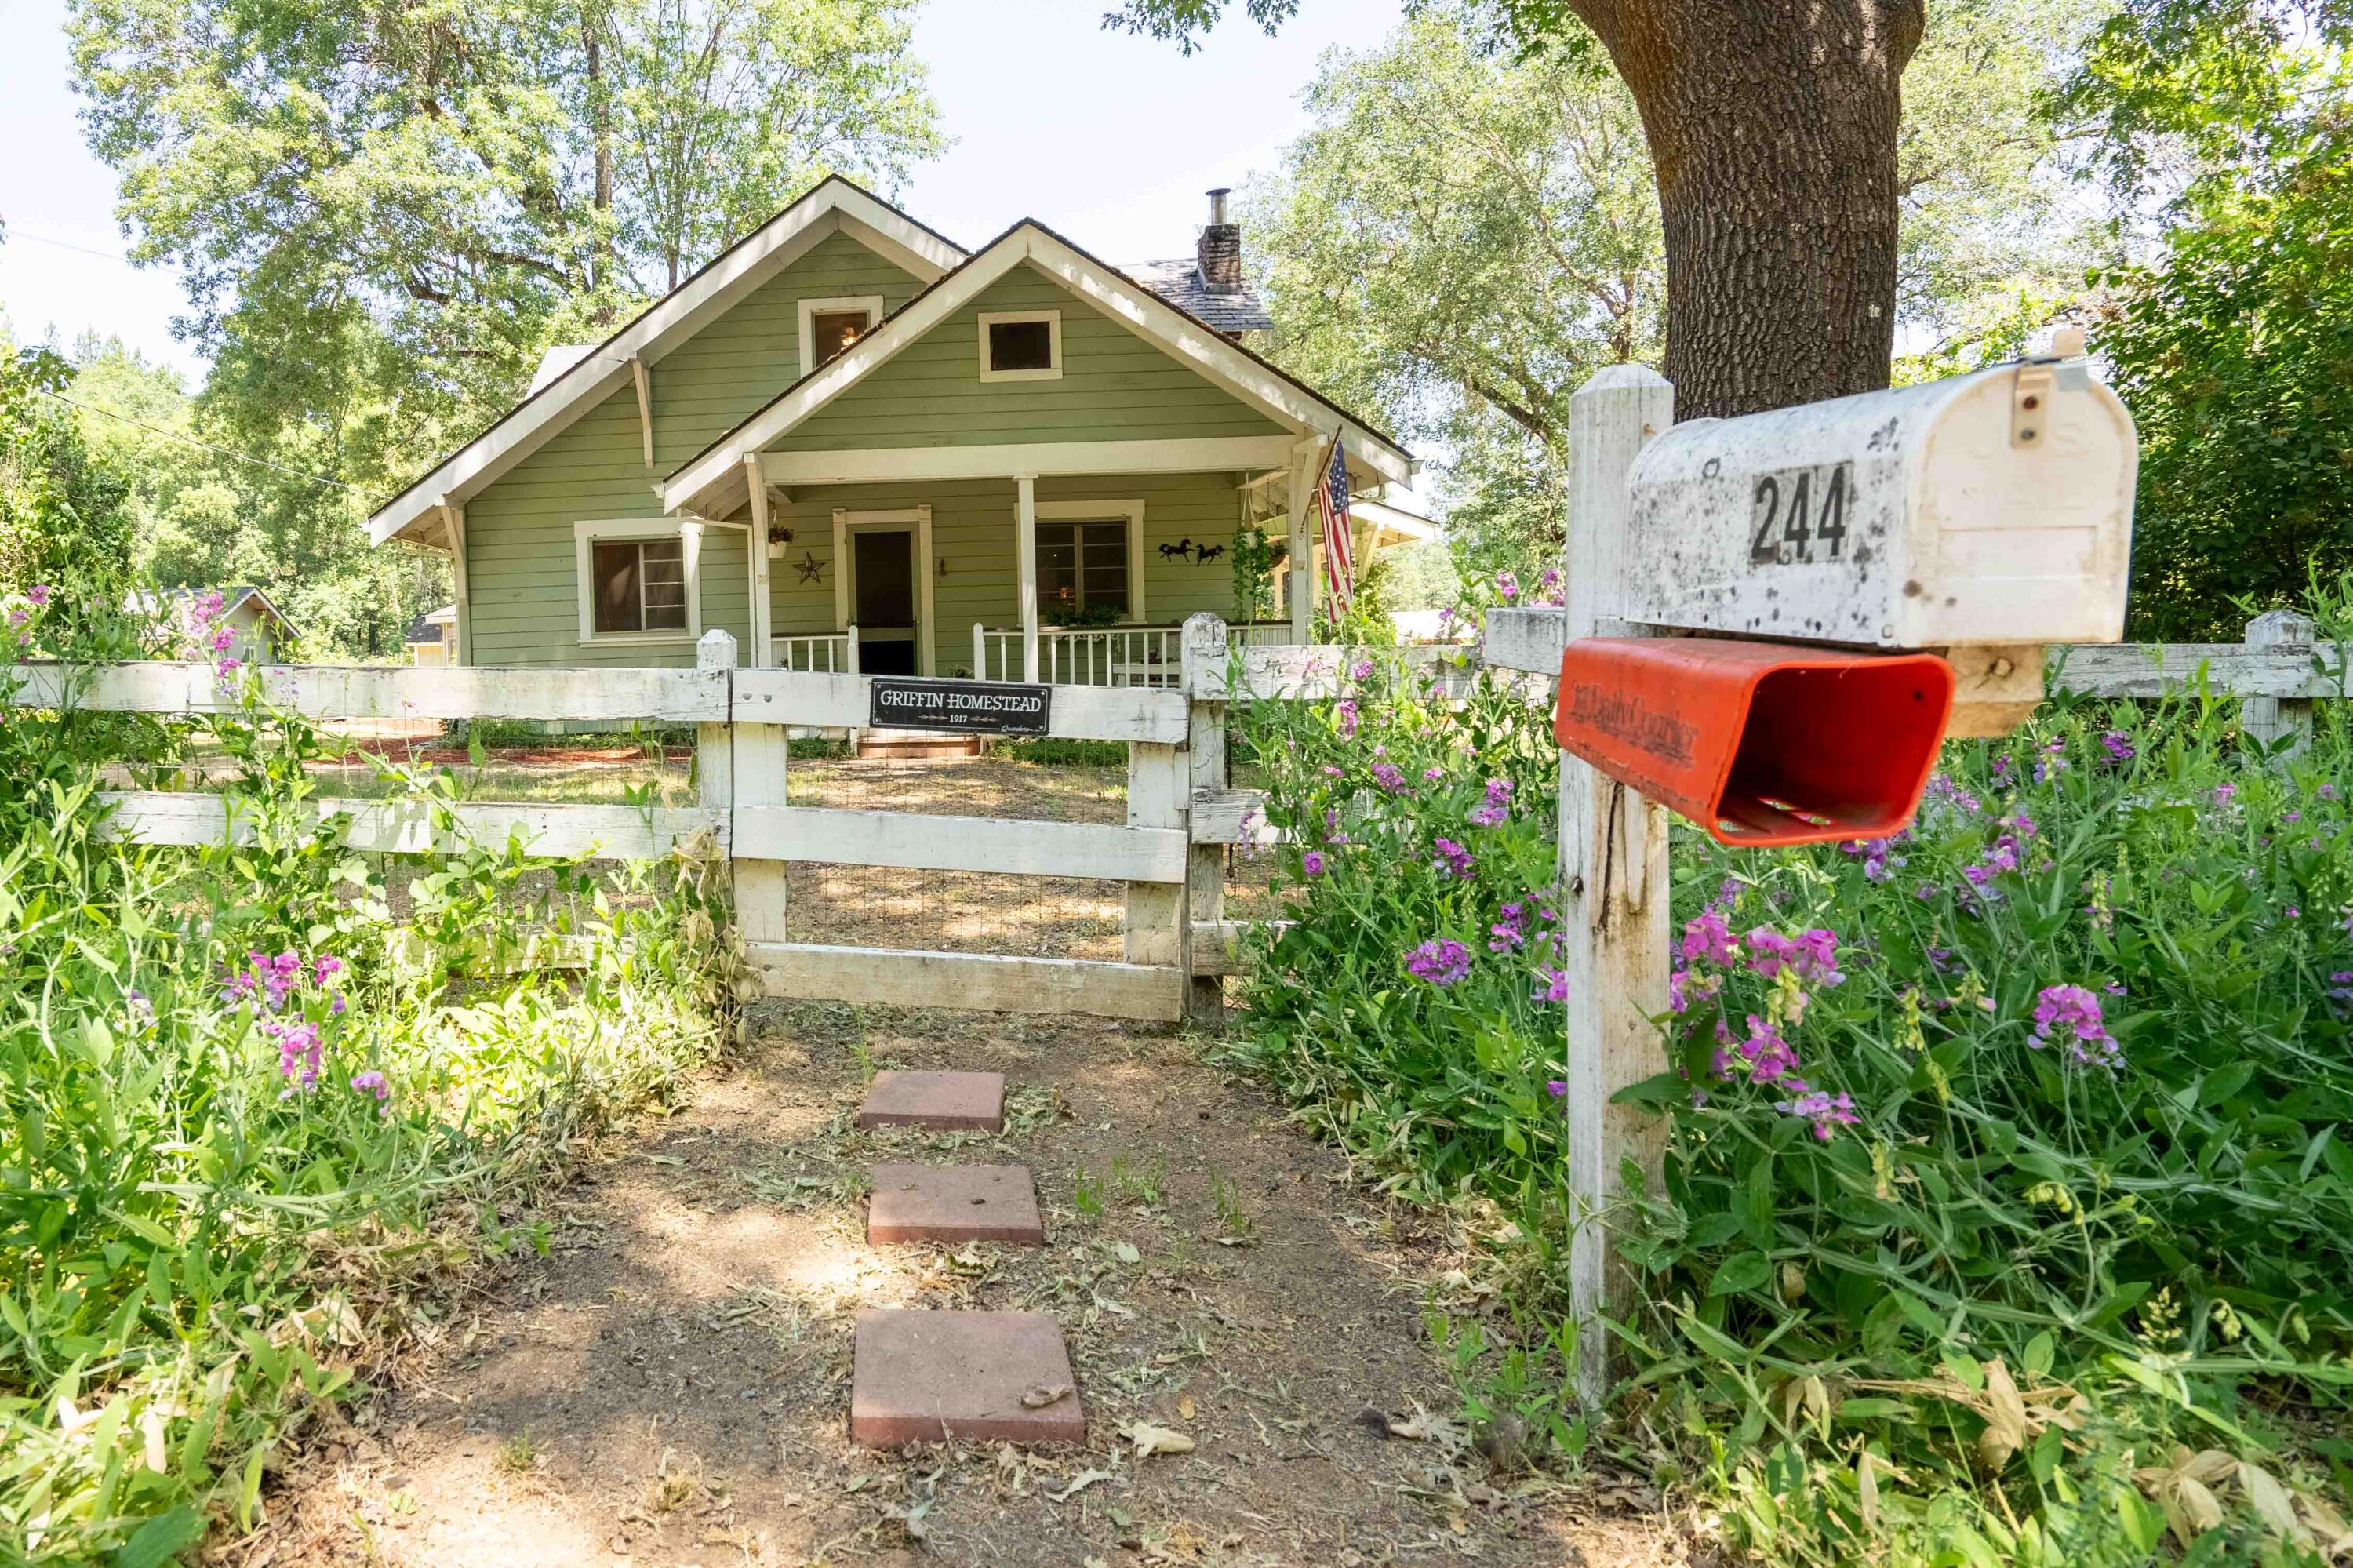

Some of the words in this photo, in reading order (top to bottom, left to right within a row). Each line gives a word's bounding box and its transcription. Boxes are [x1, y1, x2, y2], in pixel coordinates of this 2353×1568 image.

[1751, 467, 1846, 560] 244
[880, 690, 944, 708] GRIFFIN
[947, 694, 1042, 712] HOMESTEAD
[949, 715, 968, 723] 1917
